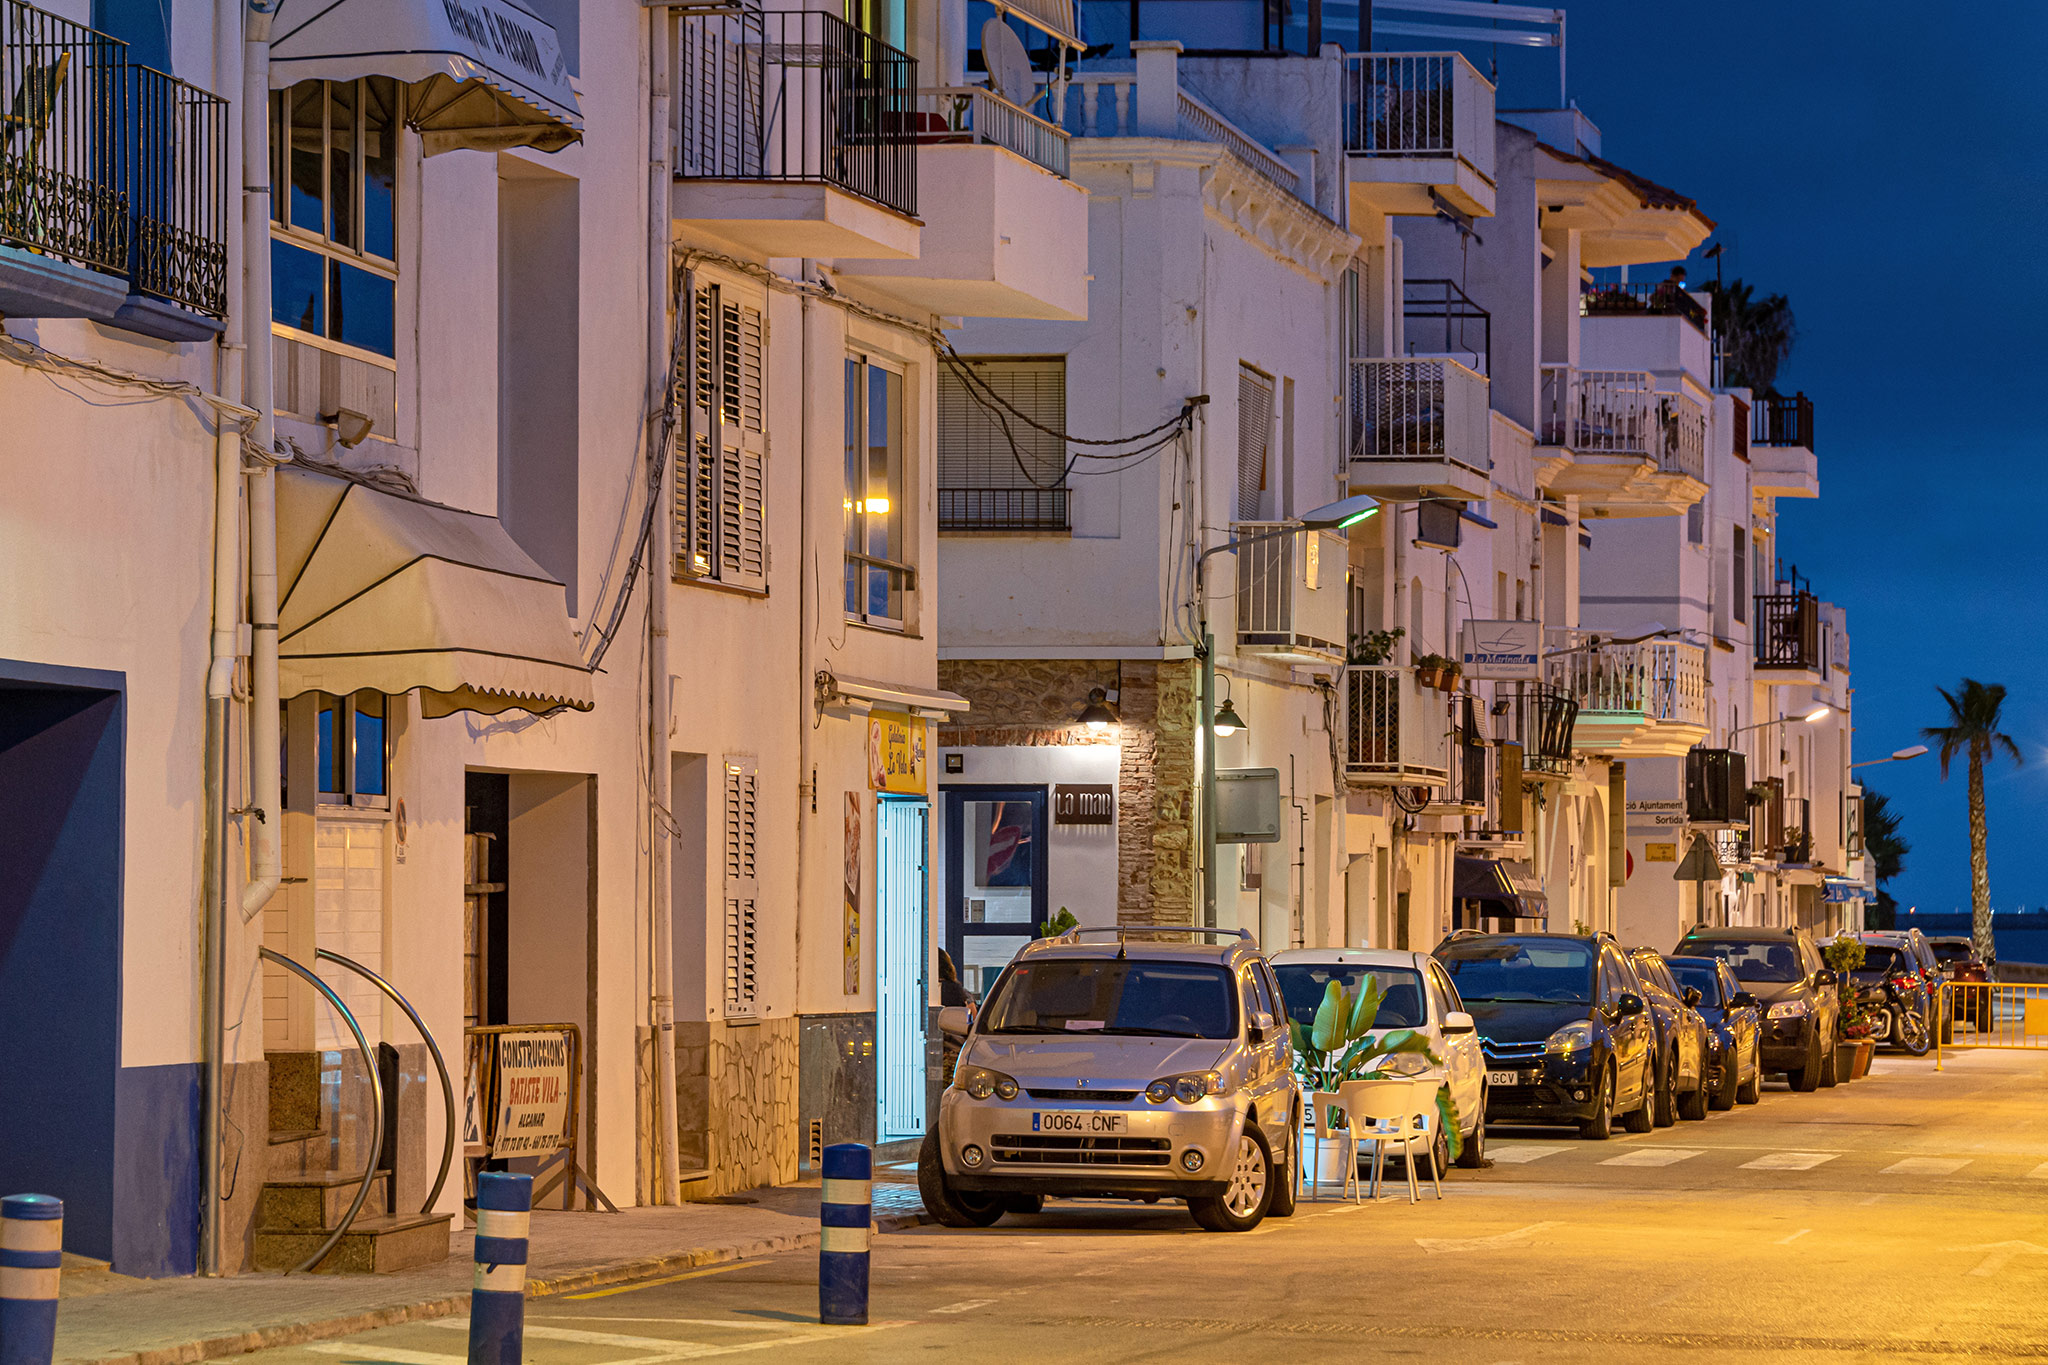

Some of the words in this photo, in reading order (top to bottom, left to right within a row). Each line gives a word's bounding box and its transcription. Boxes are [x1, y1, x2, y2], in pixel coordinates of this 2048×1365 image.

[1639, 801, 1683, 811] Ajuntament
[1655, 815, 1683, 824] Sortida
[502, 1039, 565, 1069] CONSTRUCCIONS
[1492, 1073, 1514, 1083] GCV
[510, 1076, 540, 1106] BATISTE
[541, 1076, 559, 1104] VILA
[1043, 1114, 1082, 1131] 0064
[1091, 1116, 1121, 1131] CNF
